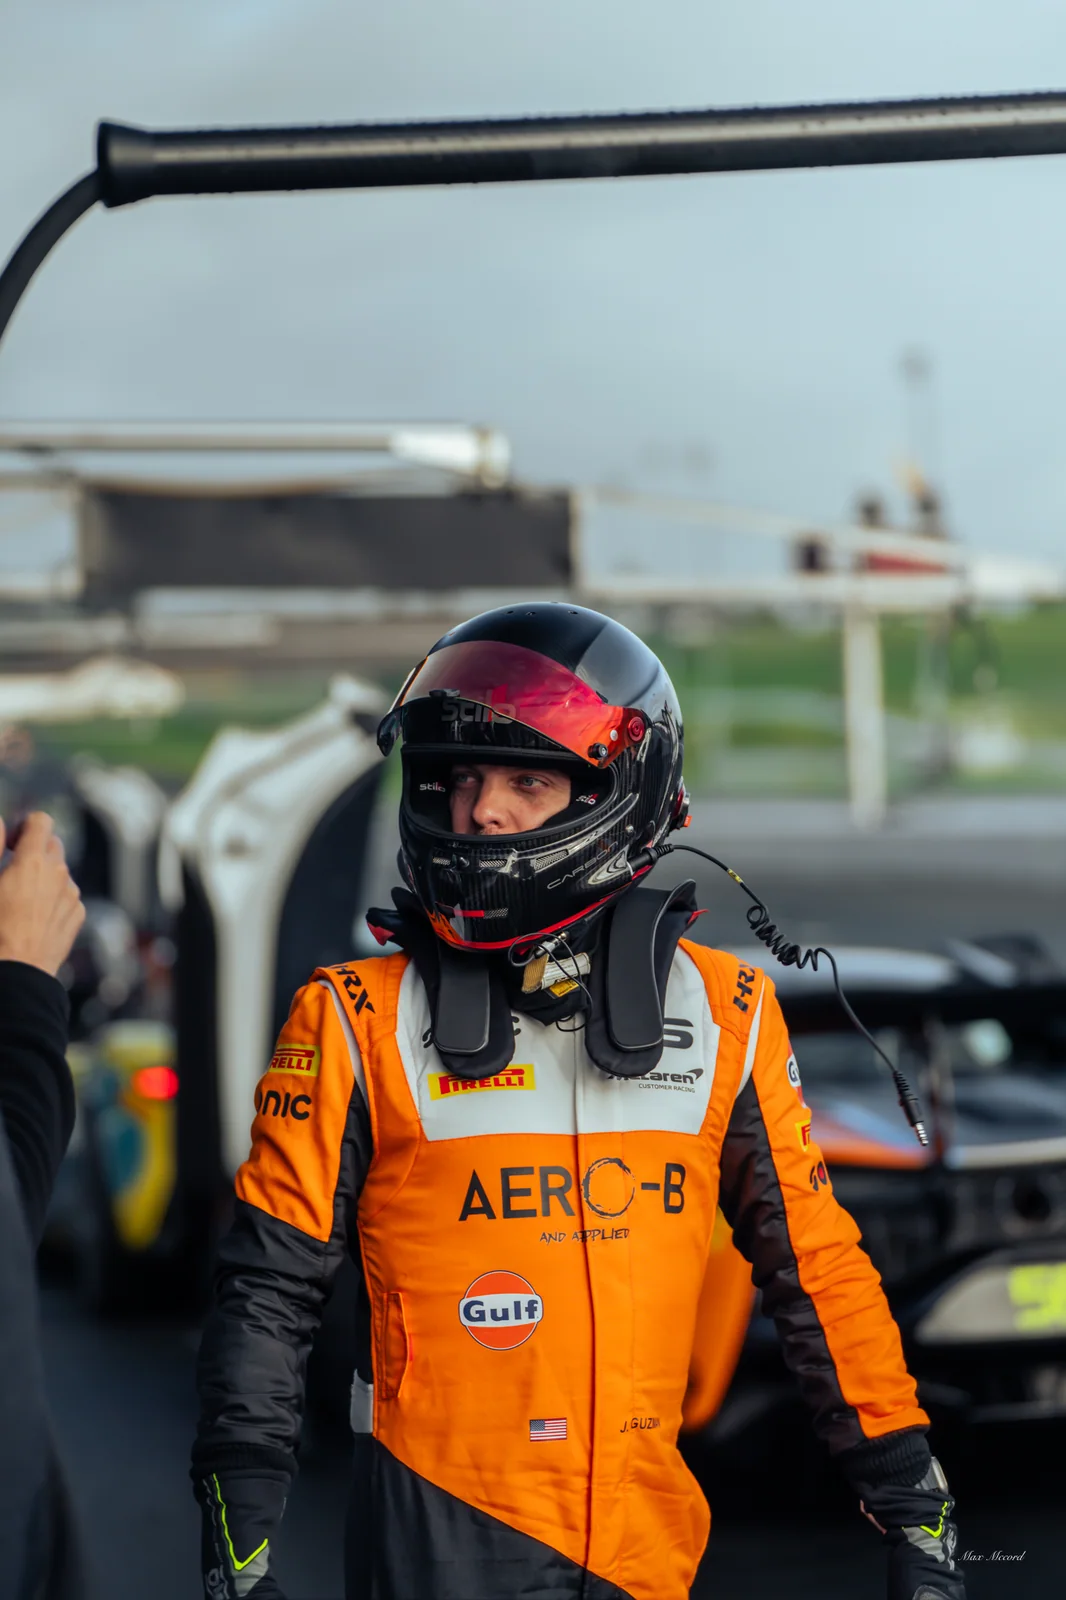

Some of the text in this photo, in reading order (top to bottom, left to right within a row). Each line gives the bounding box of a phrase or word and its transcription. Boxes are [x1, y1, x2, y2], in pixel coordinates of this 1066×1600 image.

[639, 1083, 695, 1093] CUSTOMER RACING
[539, 1228, 630, 1246] AND APPLIED
[463, 1299, 539, 1322] Gulf
